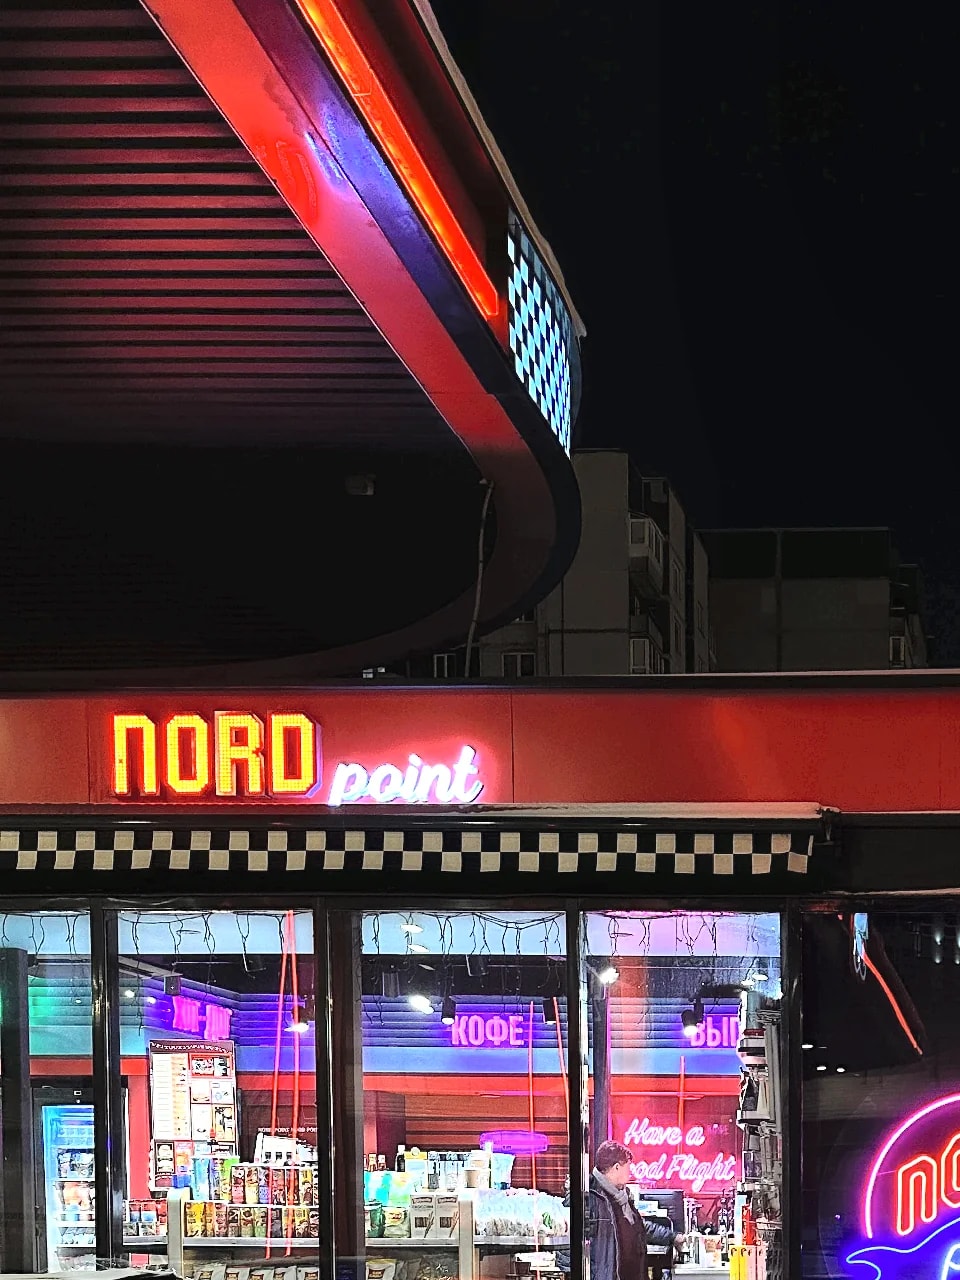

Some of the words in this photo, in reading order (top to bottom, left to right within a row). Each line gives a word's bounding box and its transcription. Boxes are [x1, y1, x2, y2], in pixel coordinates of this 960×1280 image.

[112, 711, 321, 797] NORD
[328, 745, 484, 807] point
[451, 1015, 525, 1046] КОФЕ
[623, 1117, 683, 1145] Have
[685, 1125, 706, 1146] a
[629, 1153, 667, 1180] od
[666, 1152, 737, 1193] Flight
